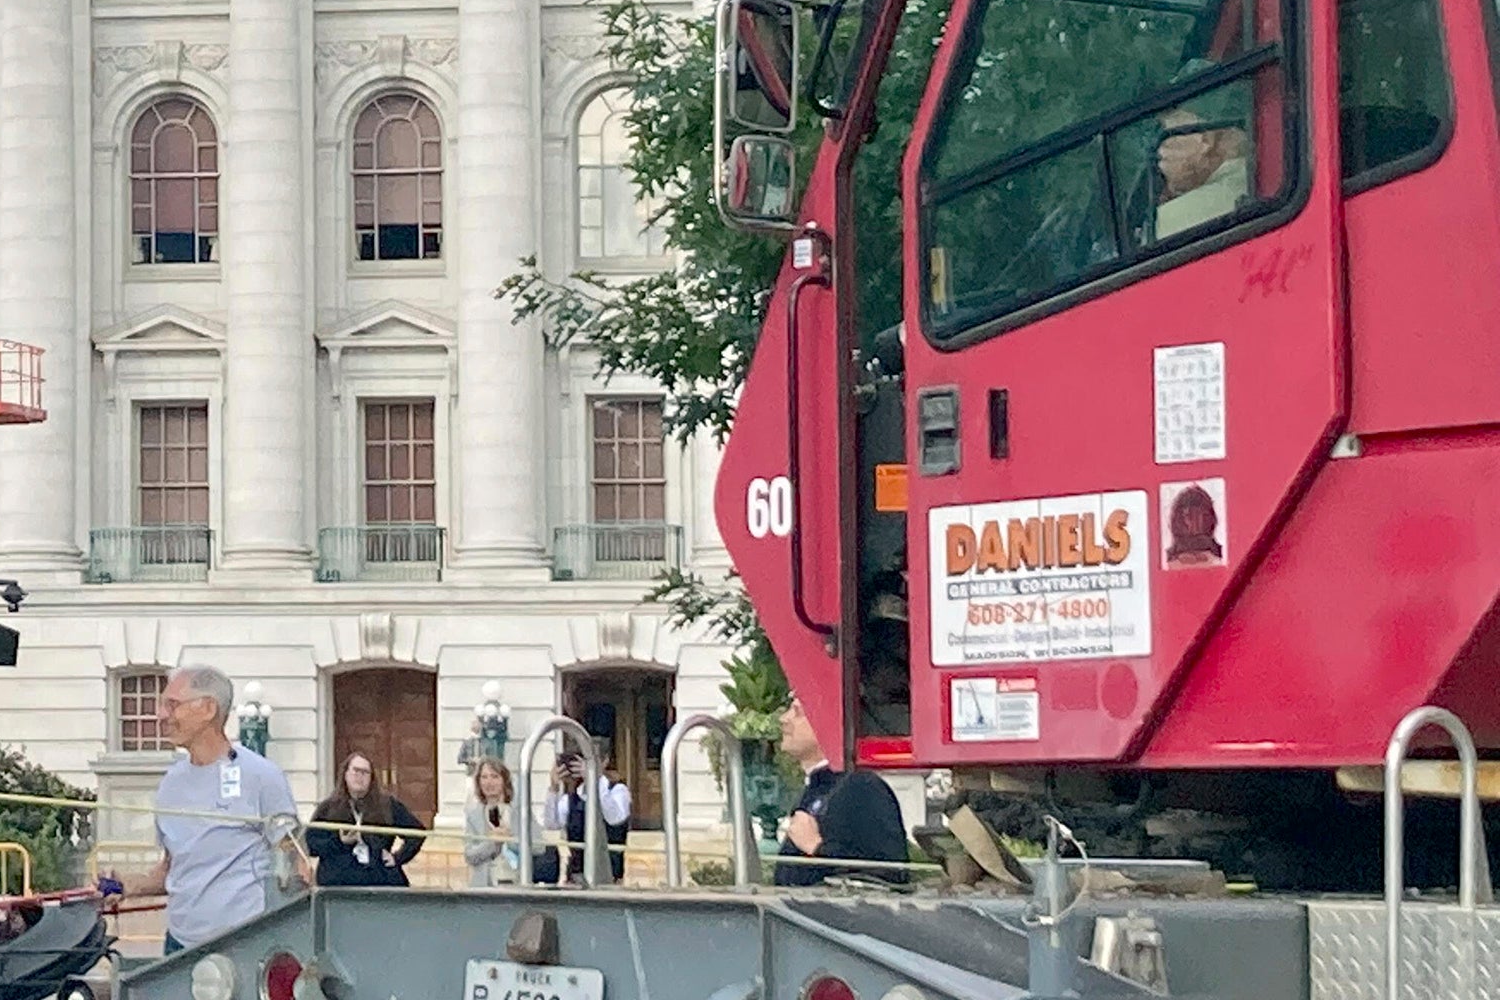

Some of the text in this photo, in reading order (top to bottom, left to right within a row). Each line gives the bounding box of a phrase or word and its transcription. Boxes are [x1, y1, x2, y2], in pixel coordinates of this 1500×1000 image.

[747, 476, 792, 539] 60
[946, 509, 1131, 577] DANIELS
[949, 572, 1130, 598] GENERAL CONTRACTORS
